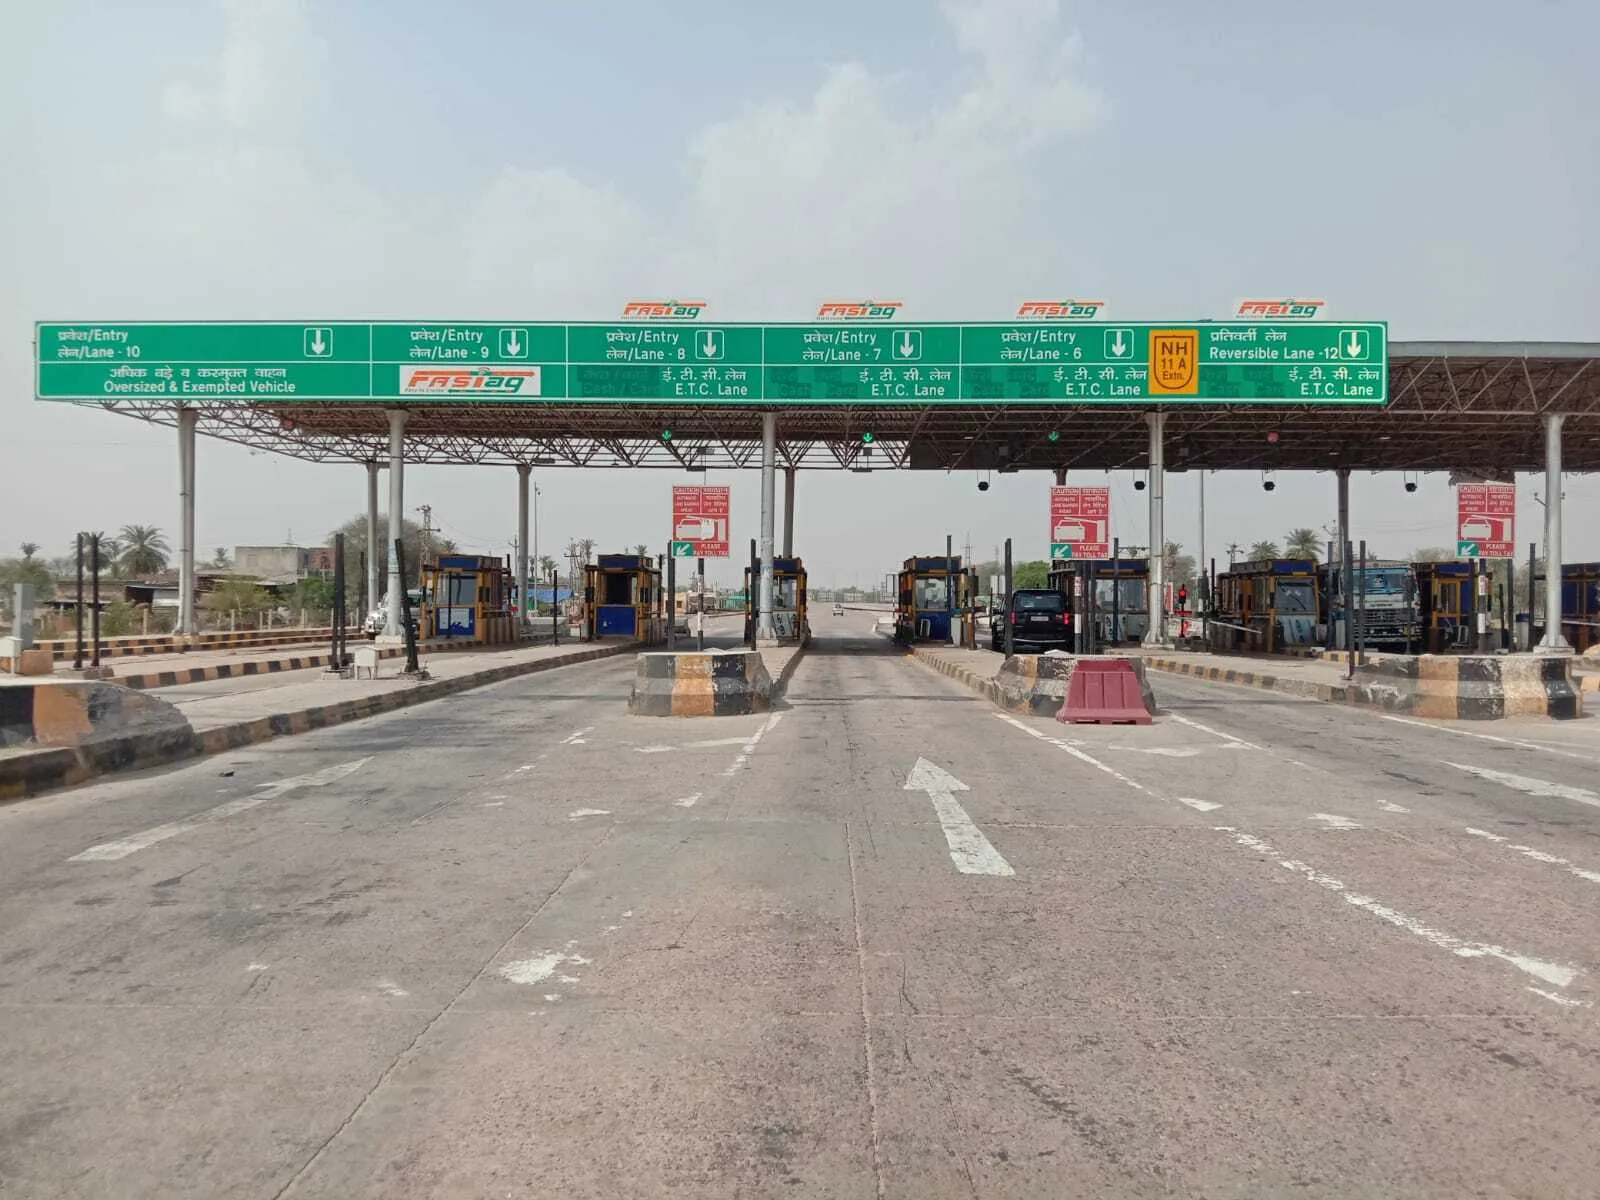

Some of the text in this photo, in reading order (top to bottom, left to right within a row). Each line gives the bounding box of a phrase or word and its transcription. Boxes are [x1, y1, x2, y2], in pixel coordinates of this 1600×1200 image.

[1264, 329, 1287, 342] लेन
[126, 346, 140, 359] 10
[481, 346, 489, 359] 9
[677, 348, 686, 360] 8
[874, 348, 881, 360] 7
[1073, 348, 1082, 360] 6
[1161, 341, 1188, 356] NH
[1210, 347, 1278, 360] Reversible
[1284, 347, 1315, 360] Lane
[1161, 358, 1187, 369] 11 A
[725, 367, 746, 381] लेन
[929, 368, 951, 382] लेन
[1125, 367, 1147, 380] लेन
[1162, 371, 1184, 381] Extn.
[1358, 368, 1380, 380] लेन
[104, 380, 296, 395] Oversized & Exempted Vehicle
[676, 383, 748, 396] E.T.C. Lane
[871, 384, 909, 396] E.T.C.
[914, 384, 945, 396] Lane
[1066, 383, 1141, 395] E.T.C. Lane
[1301, 383, 1339, 396] E.T.C.
[1343, 383, 1374, 396] Lane
